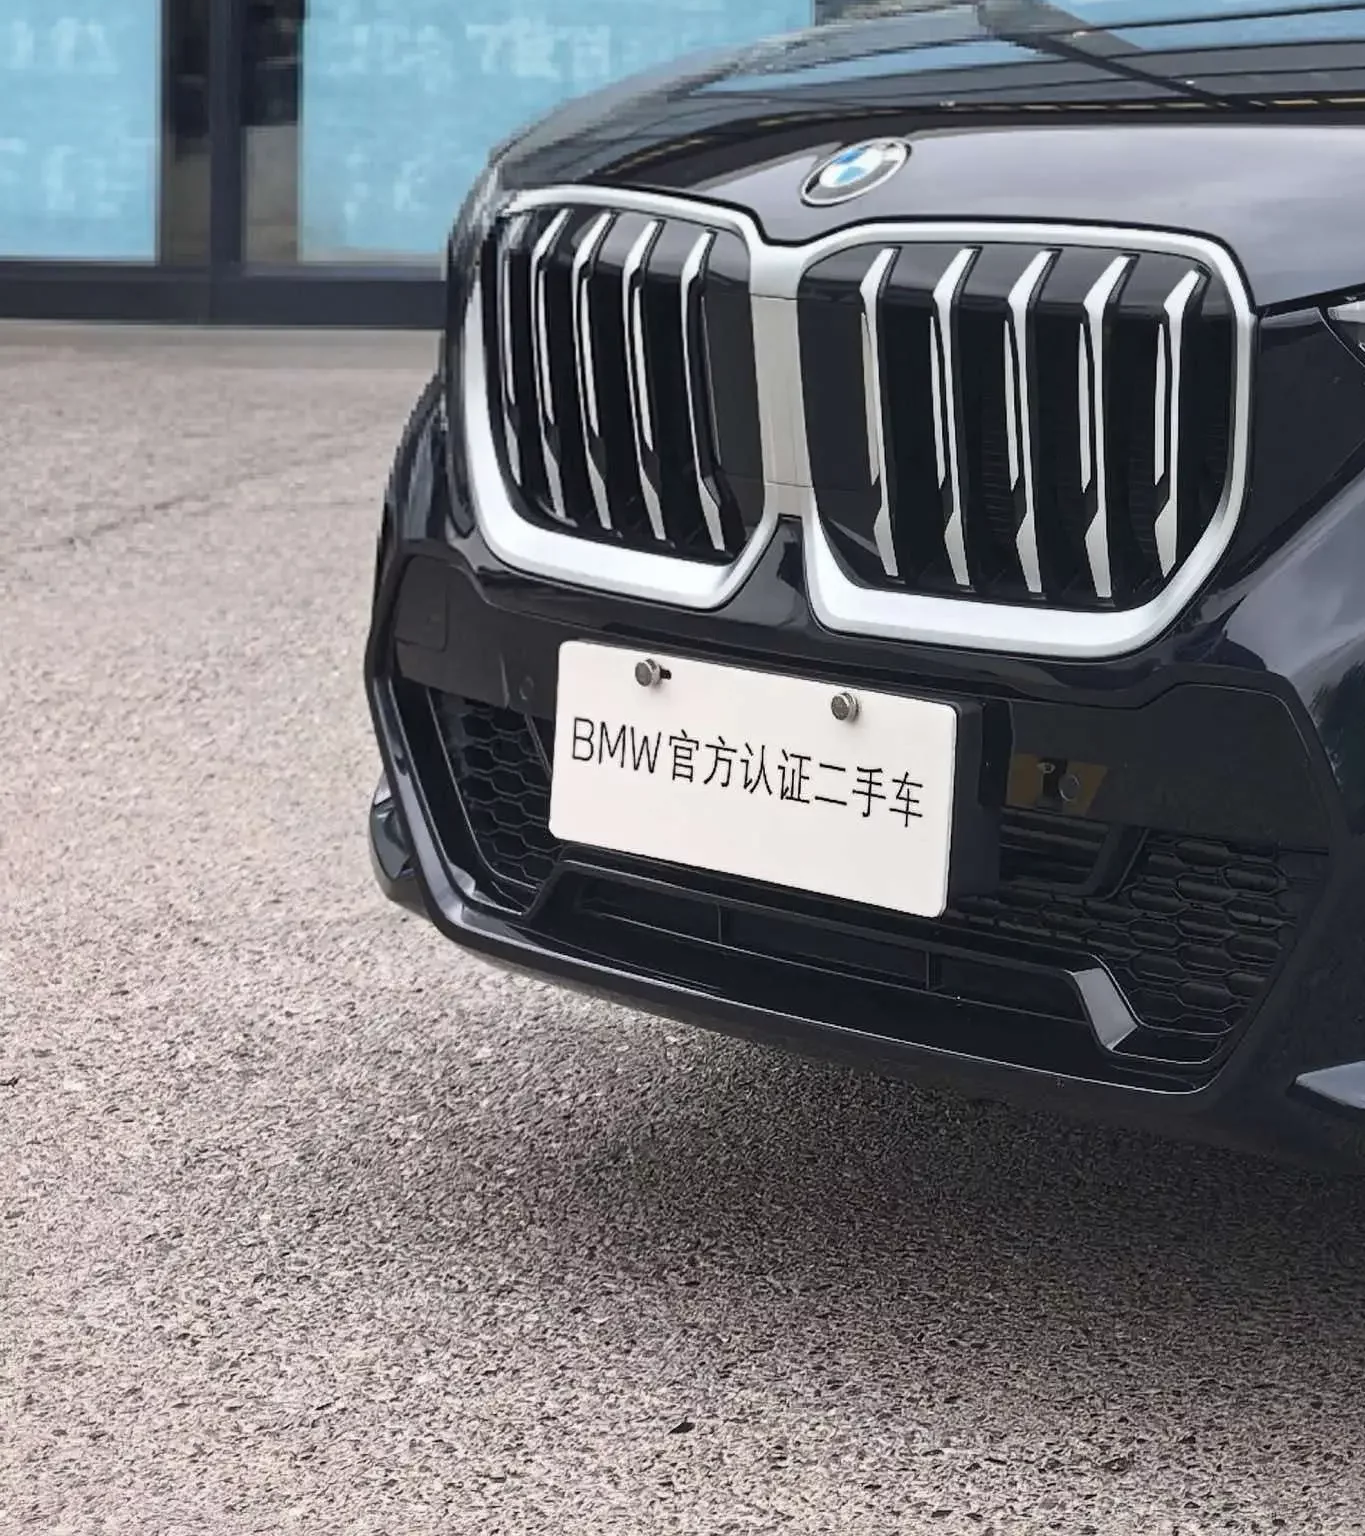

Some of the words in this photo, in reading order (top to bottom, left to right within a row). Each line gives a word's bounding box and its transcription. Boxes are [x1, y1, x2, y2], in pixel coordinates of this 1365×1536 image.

[571, 716, 923, 828] BMW官方认证二手车
